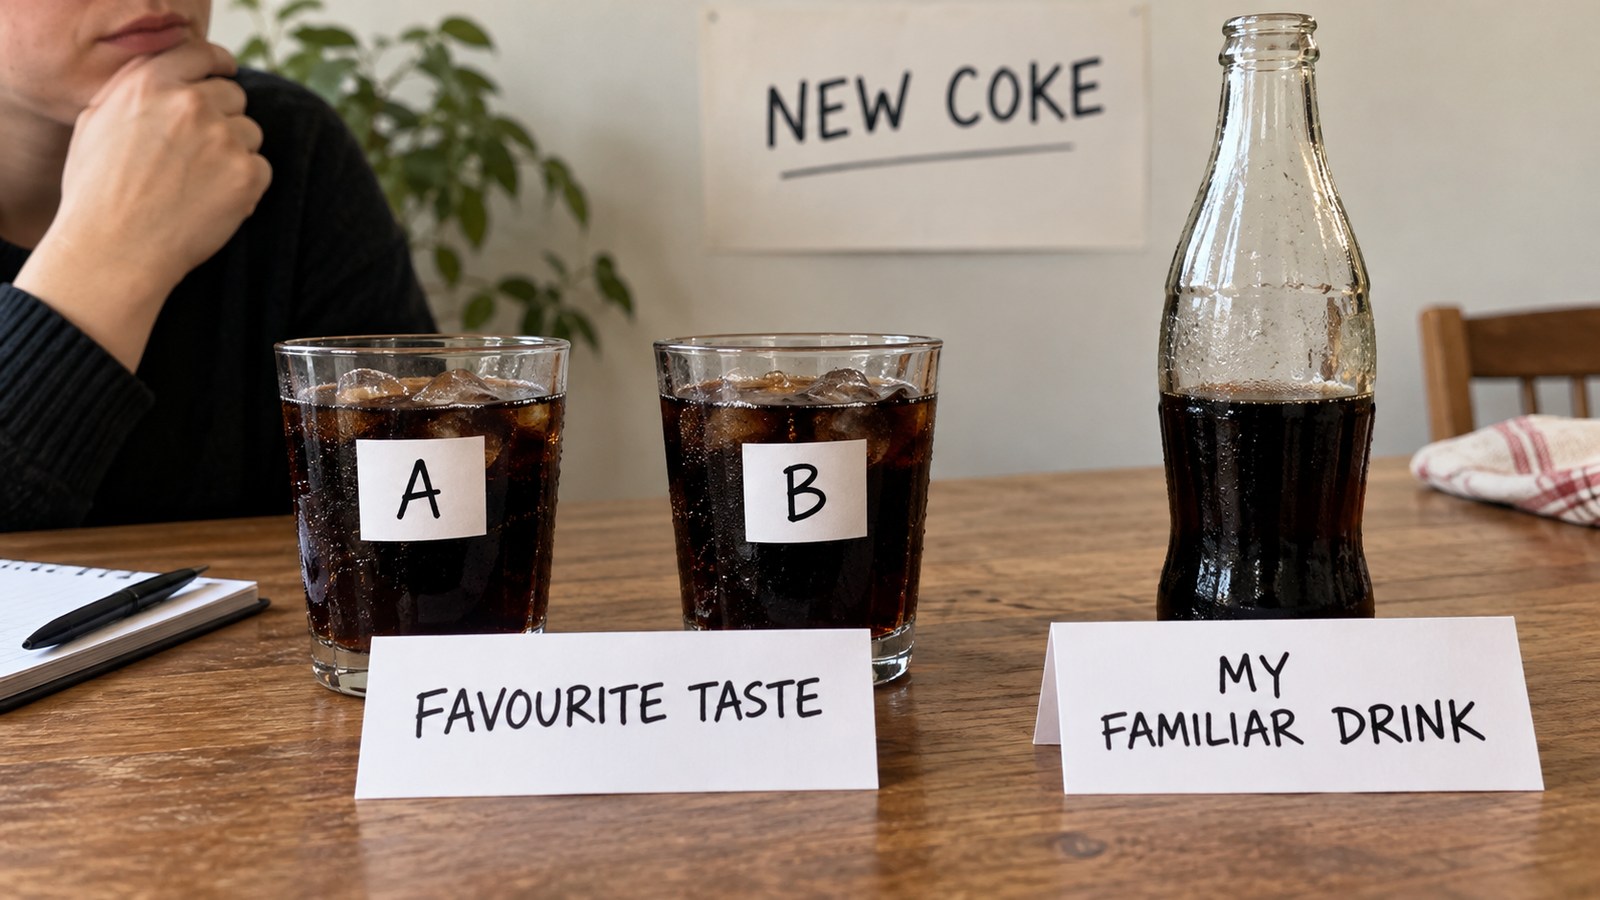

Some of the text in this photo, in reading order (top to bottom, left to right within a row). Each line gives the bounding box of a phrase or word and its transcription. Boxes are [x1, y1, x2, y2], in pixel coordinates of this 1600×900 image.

[766, 56, 1105, 149] NEW COKE
[396, 458, 442, 520] A
[782, 463, 827, 523] B
[1219, 651, 1290, 699] MY
[415, 677, 823, 739] FAVOURITE TASTE
[1100, 698, 1486, 751] FAMILIAR DRINK
